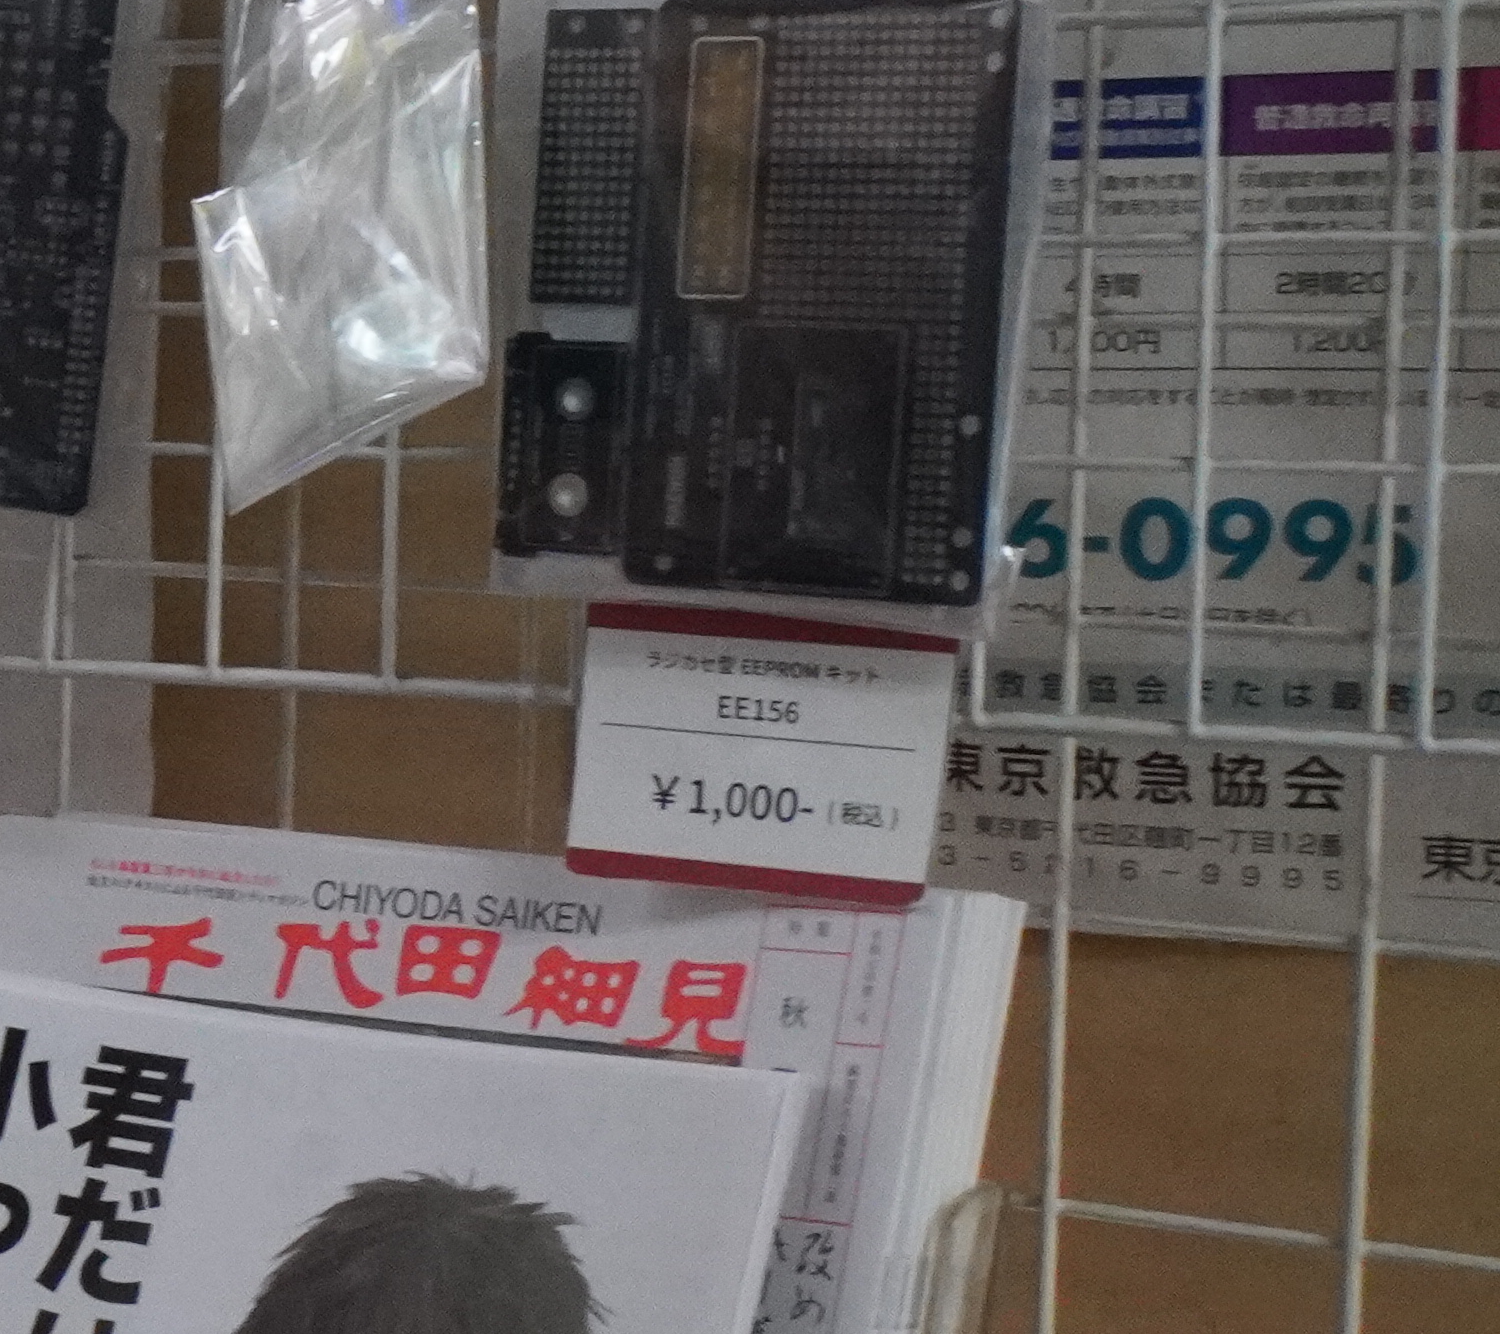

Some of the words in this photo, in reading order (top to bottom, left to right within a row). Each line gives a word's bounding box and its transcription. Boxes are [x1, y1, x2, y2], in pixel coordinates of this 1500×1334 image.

[718, 695, 800, 724] EE156
[651, 773, 814, 825] ¥1,000-
[310, 878, 472, 925] CHIYODA
[478, 896, 604, 938] SAIKEN
[100, 918, 749, 1055] 千代田細見
